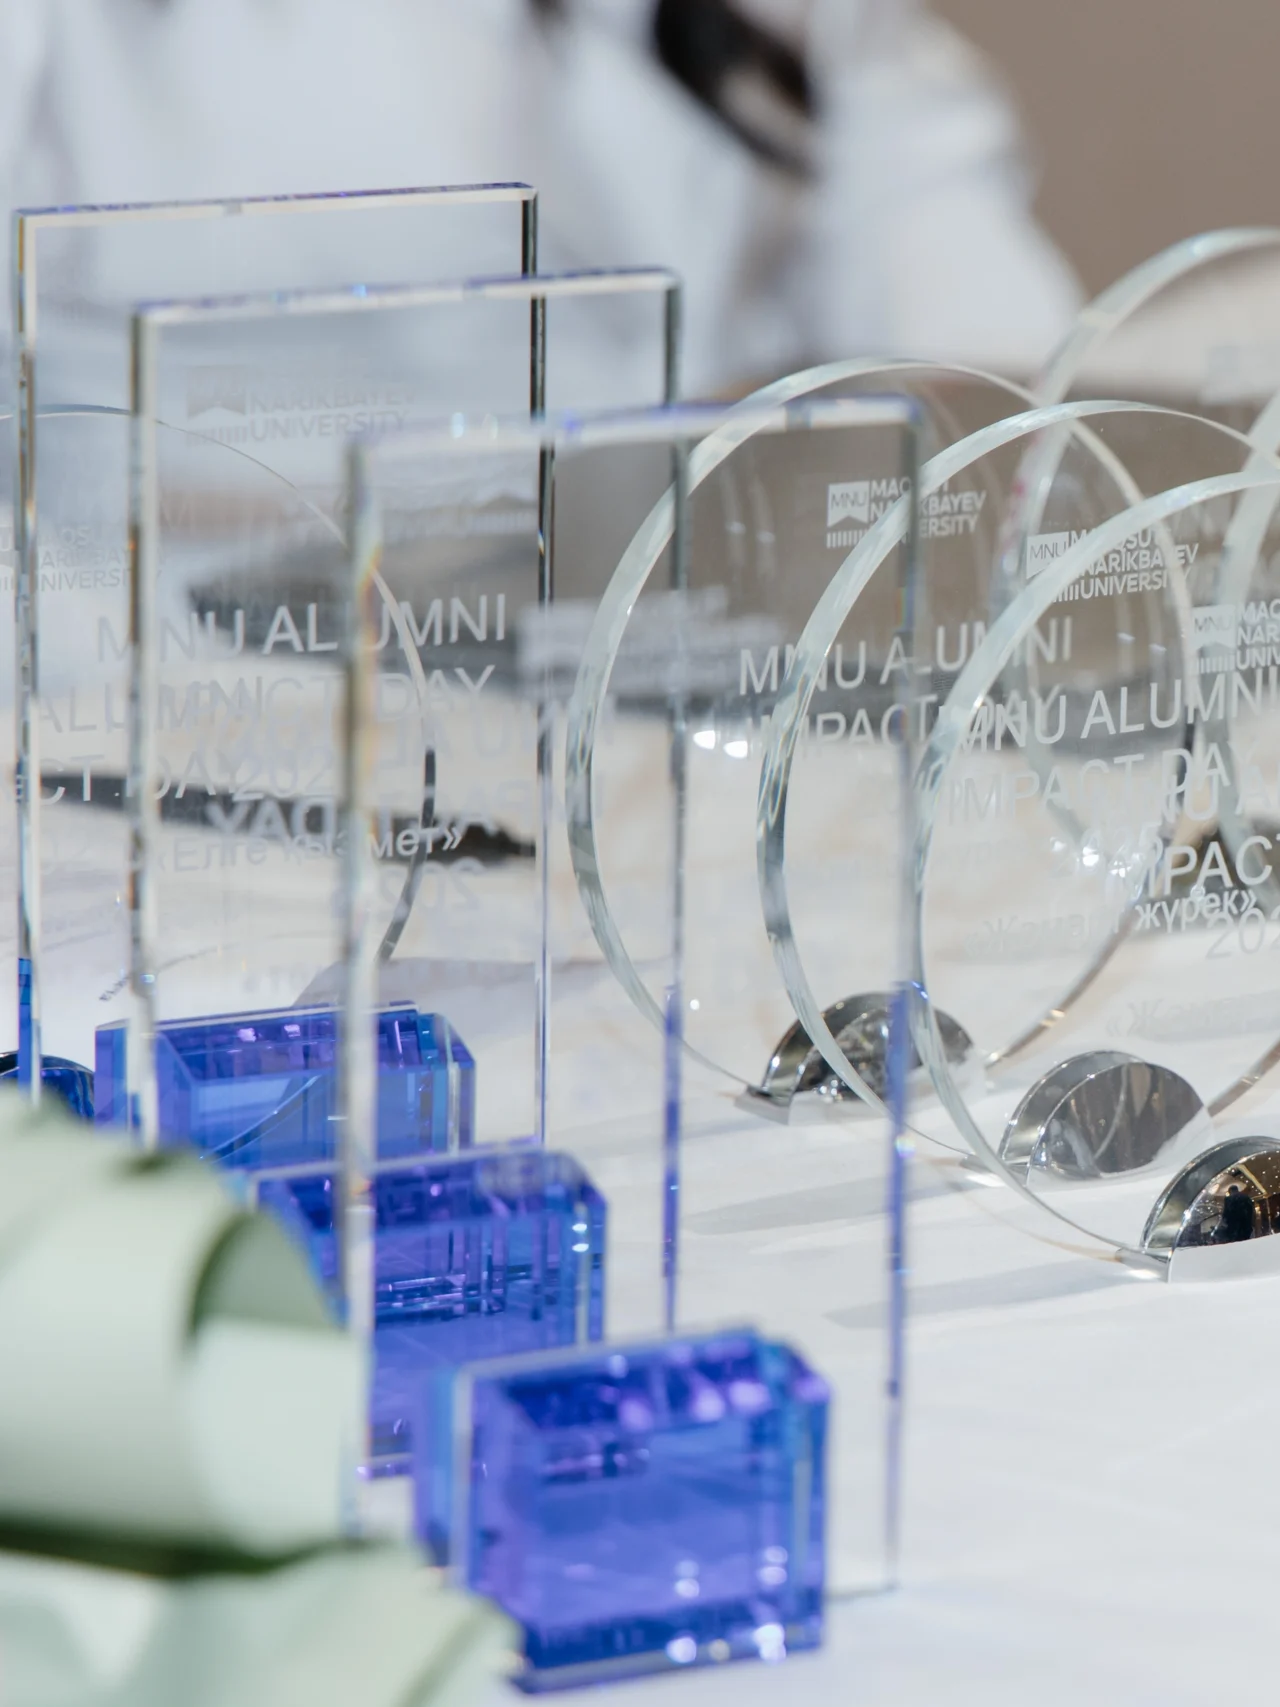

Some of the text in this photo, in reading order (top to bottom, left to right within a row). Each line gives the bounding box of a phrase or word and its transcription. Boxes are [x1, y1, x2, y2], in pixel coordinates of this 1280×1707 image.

[250, 409, 411, 443] UNIVERSITY
[1080, 667, 1278, 740] ALUMNI
[233, 745, 334, 801] 202
[948, 753, 1145, 826] IMPACT
